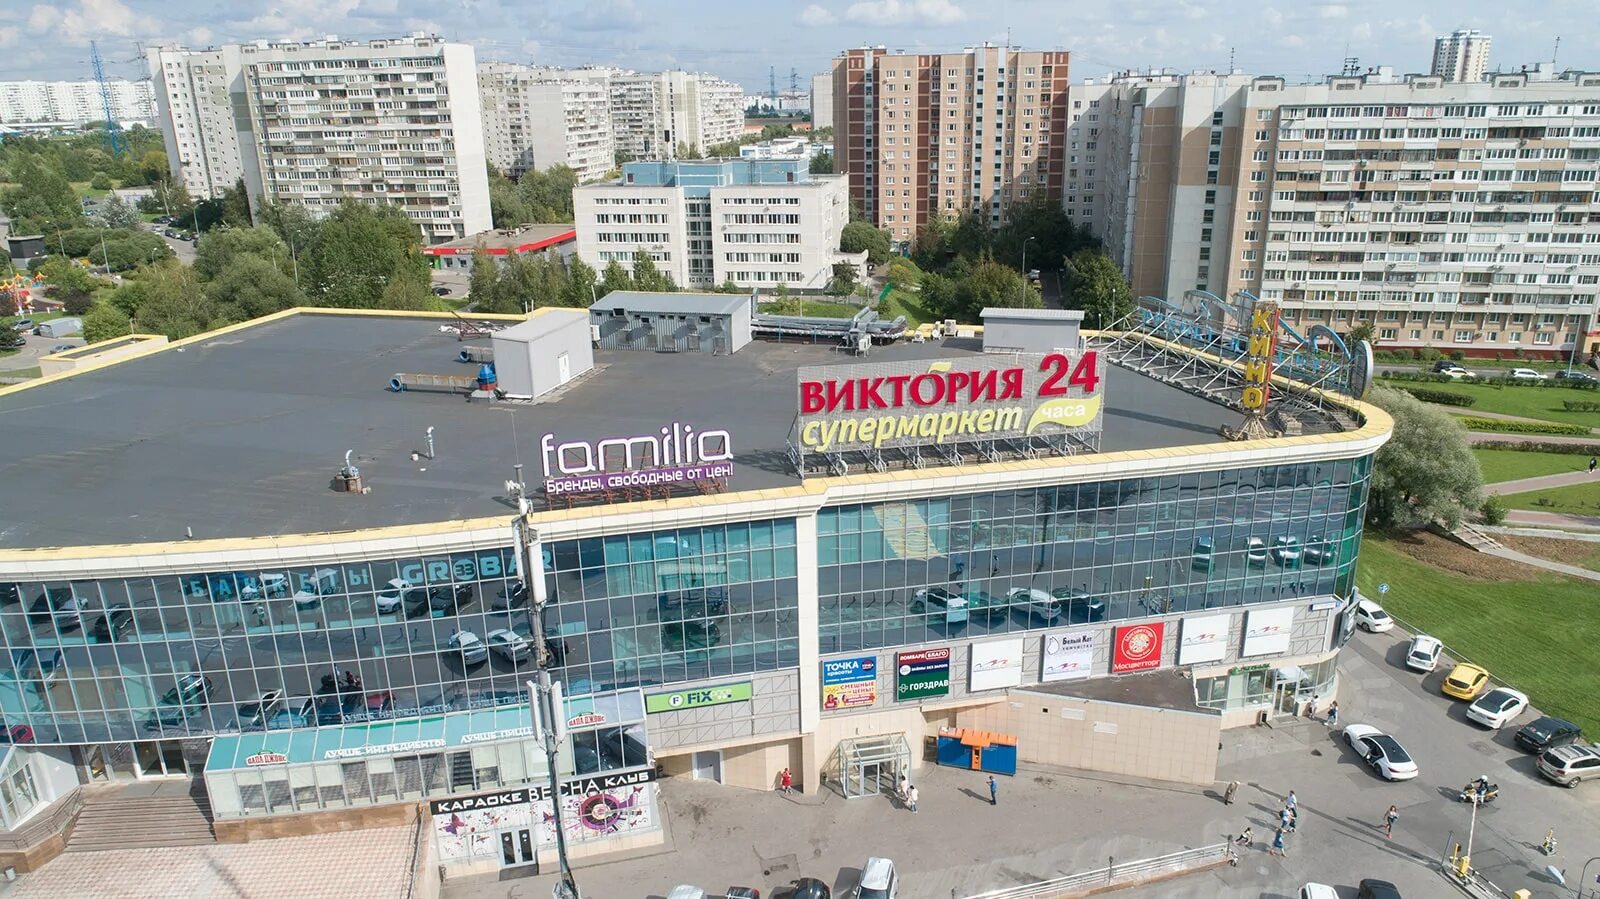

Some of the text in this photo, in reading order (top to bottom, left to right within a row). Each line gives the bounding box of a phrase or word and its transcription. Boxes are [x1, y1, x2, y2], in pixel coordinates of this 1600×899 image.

[1242, 309, 1273, 408] КИНО
[800, 350, 1100, 416] ВИКТОРИЯ 24
[1041, 404, 1087, 419] часа
[802, 405, 1024, 452] супермаркет
[540, 422, 734, 477] familia
[546, 463, 734, 494] Бренды, свободные от цен!
[825, 661, 859, 671] ТОЧКА
[1114, 660, 1160, 669] Мосцветторг
[910, 680, 949, 690] ГОРЗДРАВ
[460, 726, 534, 744] ЛУЧШЕ ПИЦЦ
[324, 739, 447, 759] ЛУЧШЕ ИНГРЕДИЕНТЫ
[438, 771, 649, 812] КАРАОКЕ ВЕСНА КЛУБ
